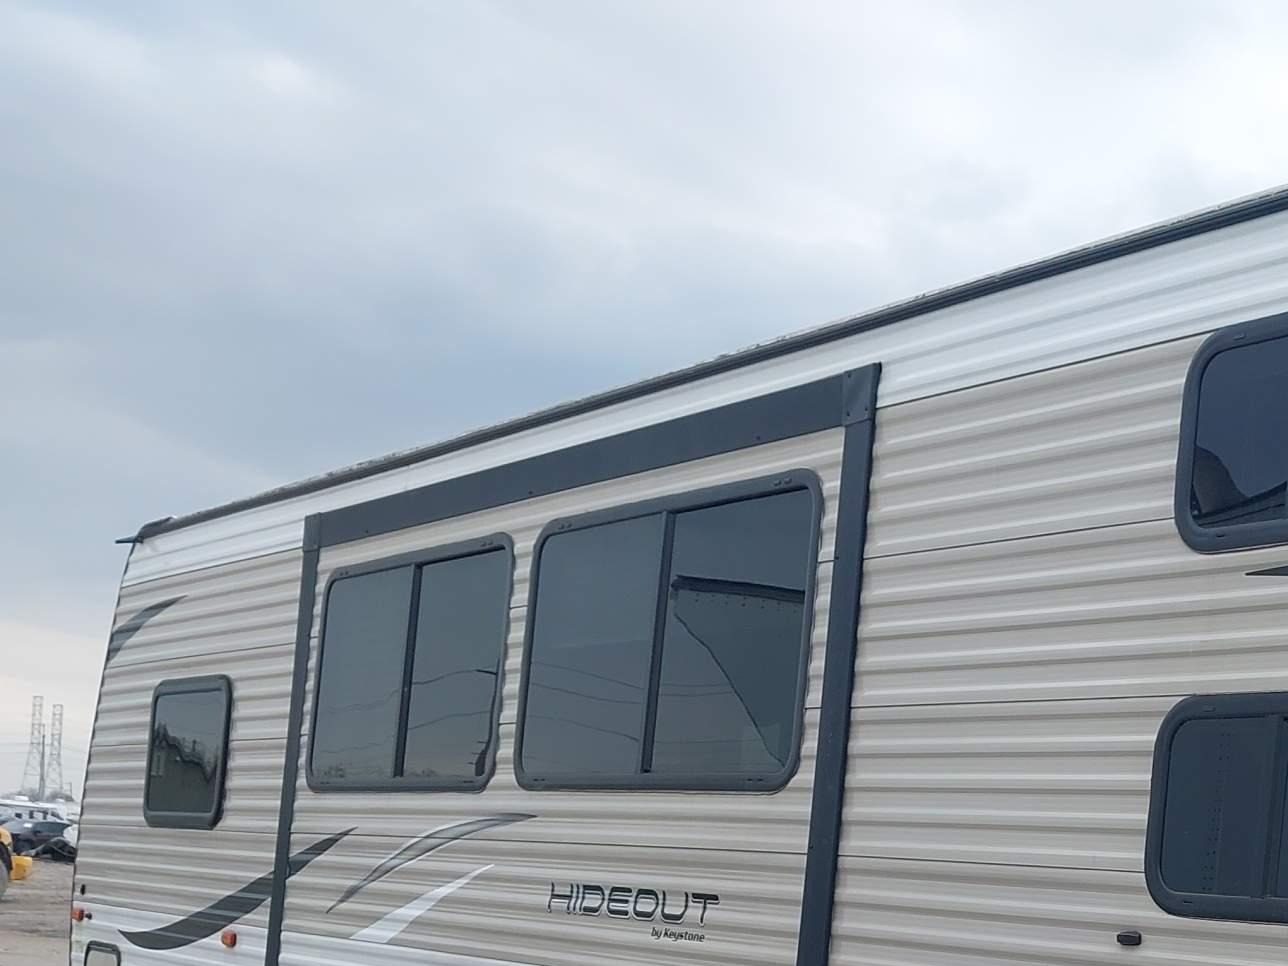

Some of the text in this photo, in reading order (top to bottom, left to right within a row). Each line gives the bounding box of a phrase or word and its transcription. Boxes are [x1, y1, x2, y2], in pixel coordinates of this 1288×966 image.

[546, 881, 721, 927] HIDEOUT
[651, 927, 705, 942] by Keystone
